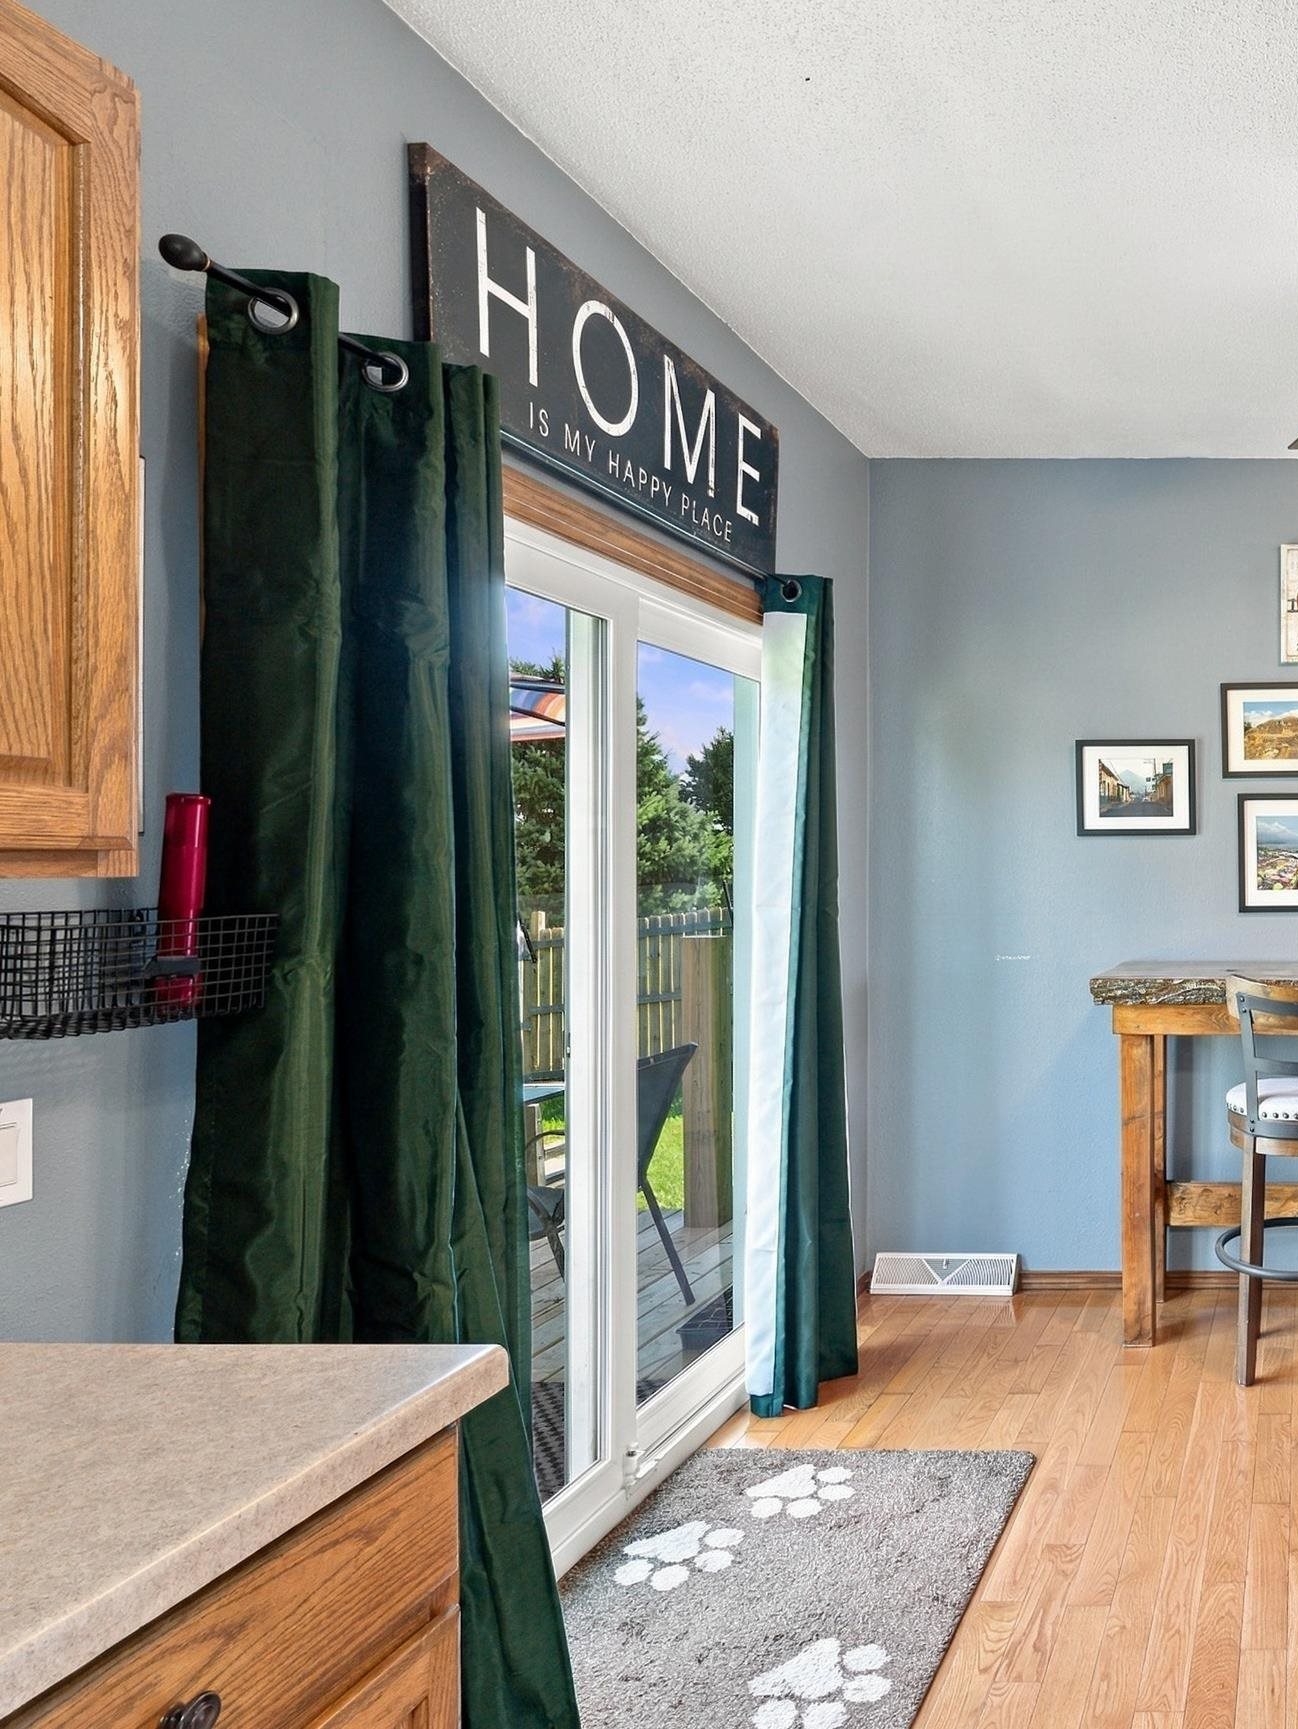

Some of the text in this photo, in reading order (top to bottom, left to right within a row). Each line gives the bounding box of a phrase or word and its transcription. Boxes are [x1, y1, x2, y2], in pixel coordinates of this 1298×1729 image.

[475, 207, 763, 526] HOME
[528, 402, 733, 544] IS MY HAPPY PLACE
